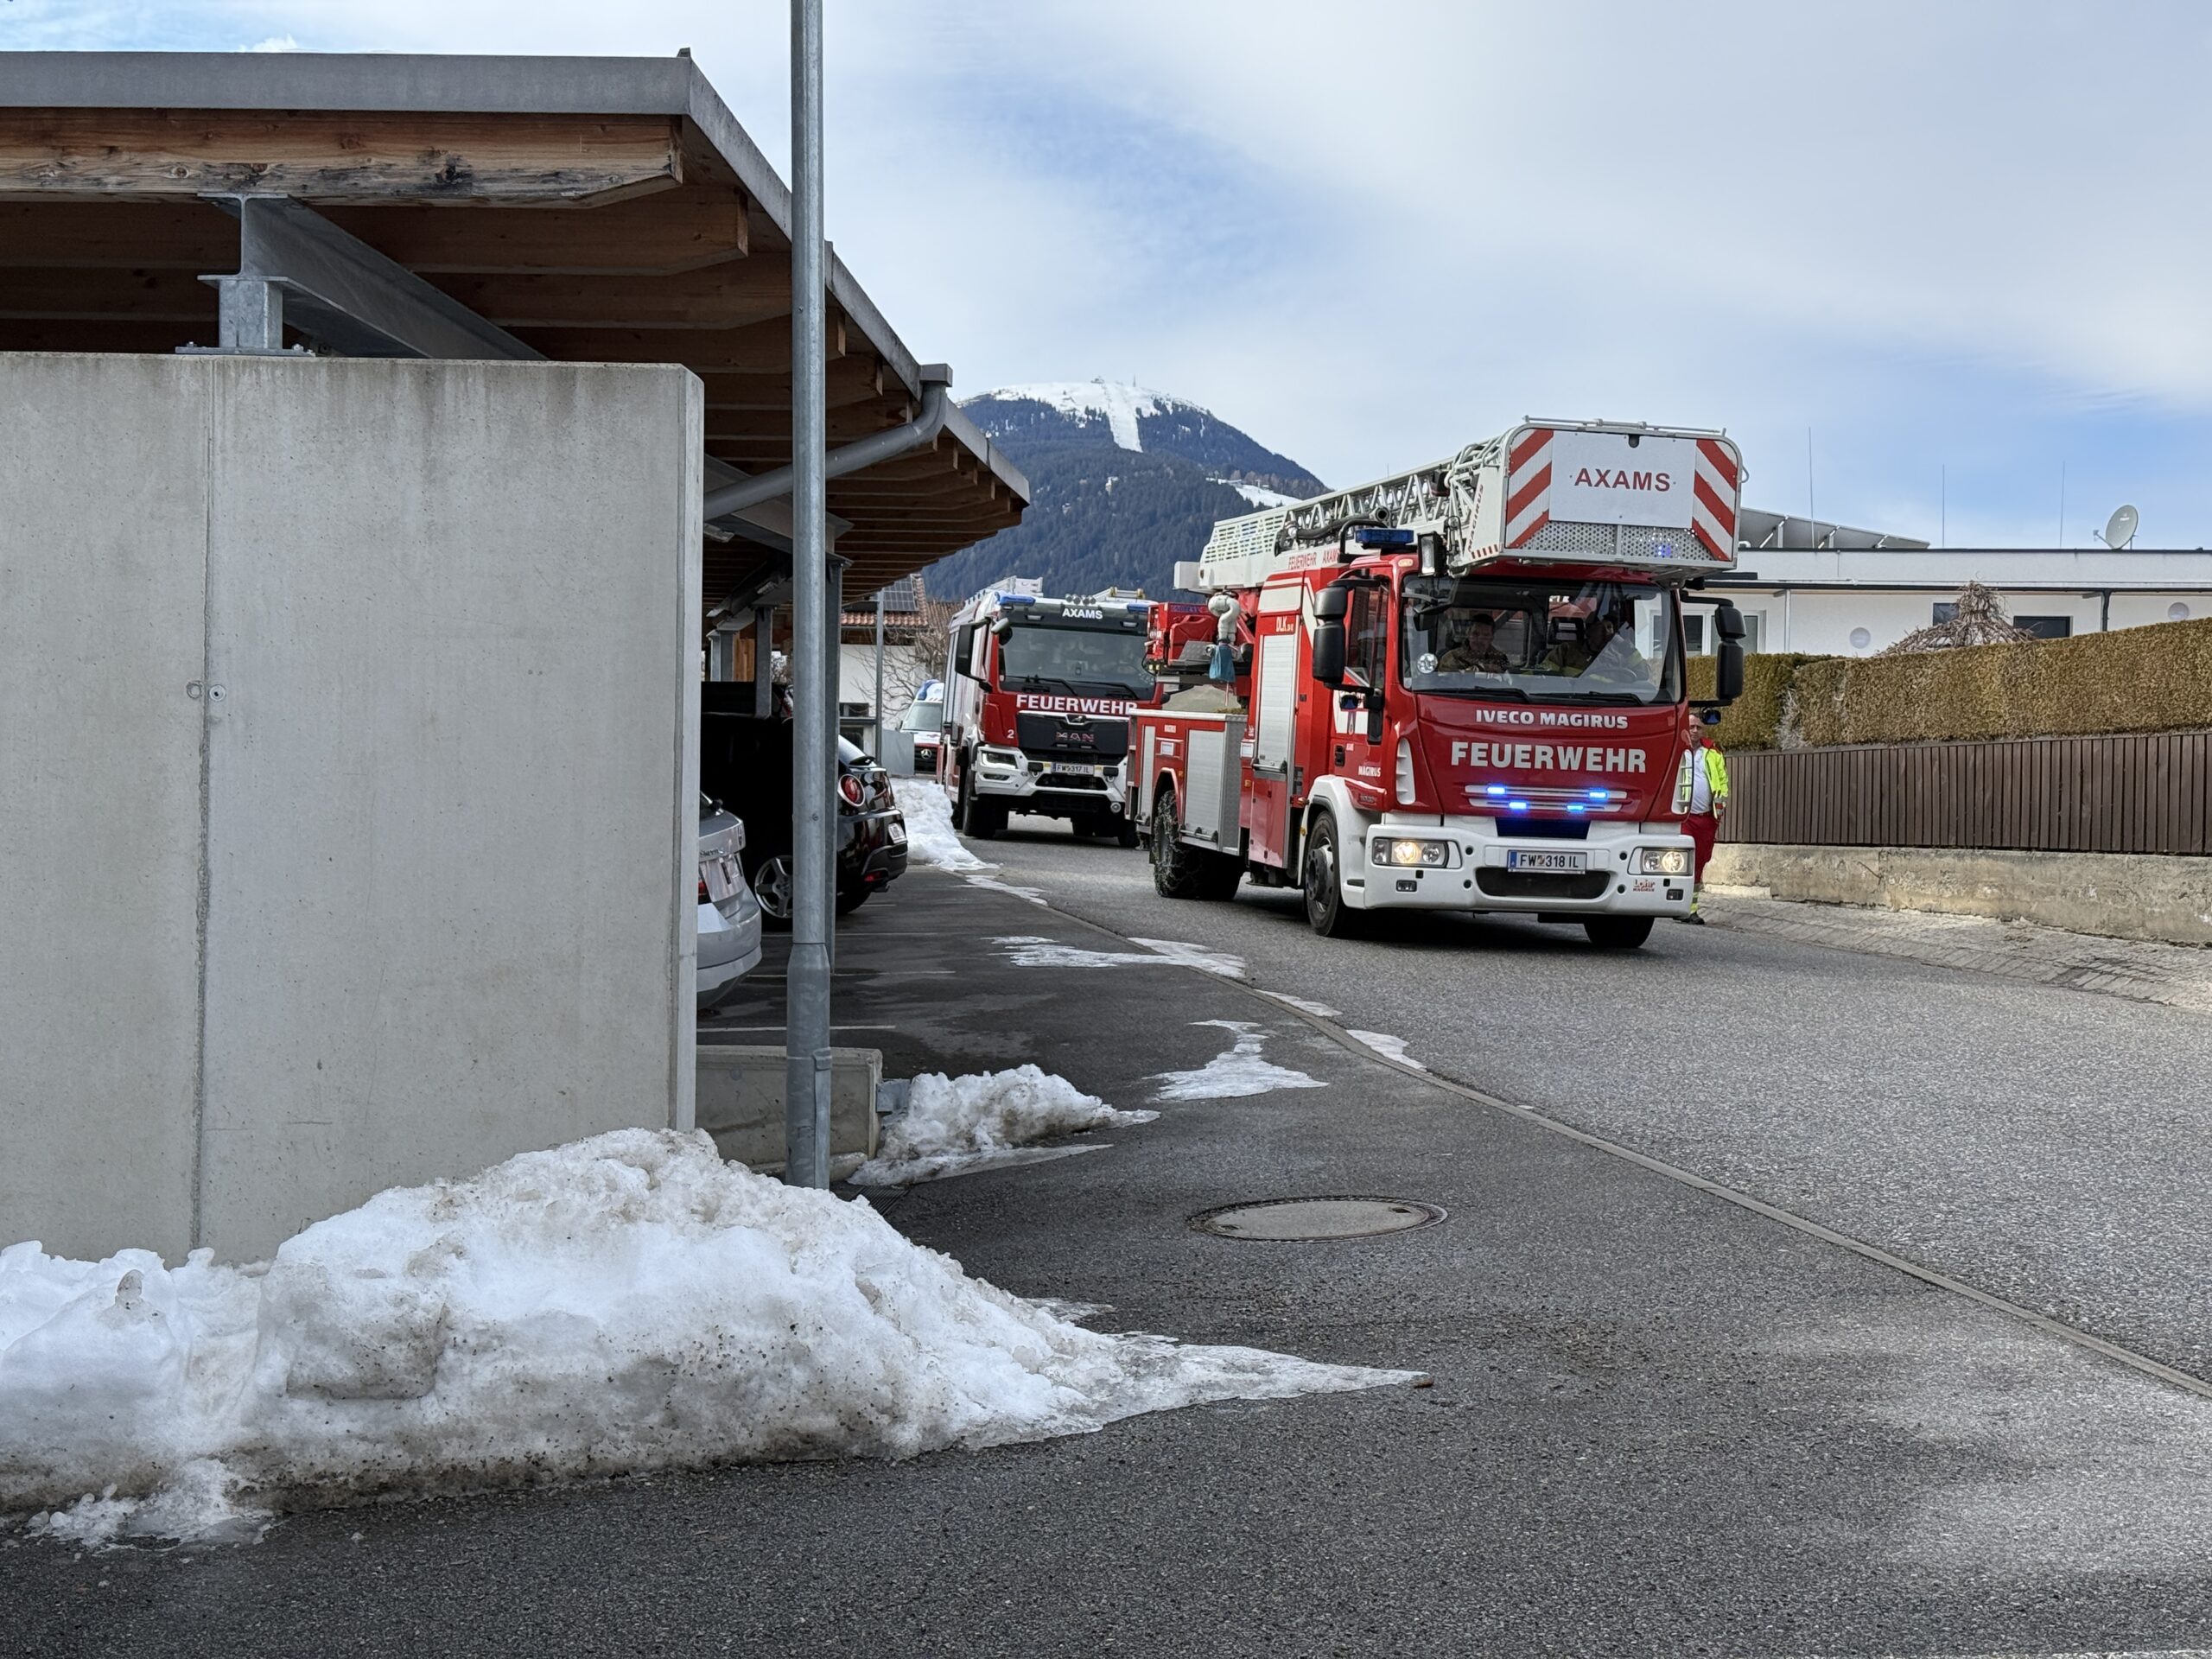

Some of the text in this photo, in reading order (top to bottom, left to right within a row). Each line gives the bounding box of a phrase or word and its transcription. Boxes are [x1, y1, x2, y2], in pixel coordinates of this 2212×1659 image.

[1573, 467, 1671, 493] AXAMS
[1322, 548, 1340, 564] AXAM
[1062, 607, 1103, 620] AXAMS
[1476, 709, 1629, 729] IVECO MAGIRUS
[1007, 729, 1015, 739] 2
[1055, 731, 1095, 742] MAN
[1451, 741, 1647, 773] FEUERWEHR
[1357, 765, 1382, 778] MAGIRUS
